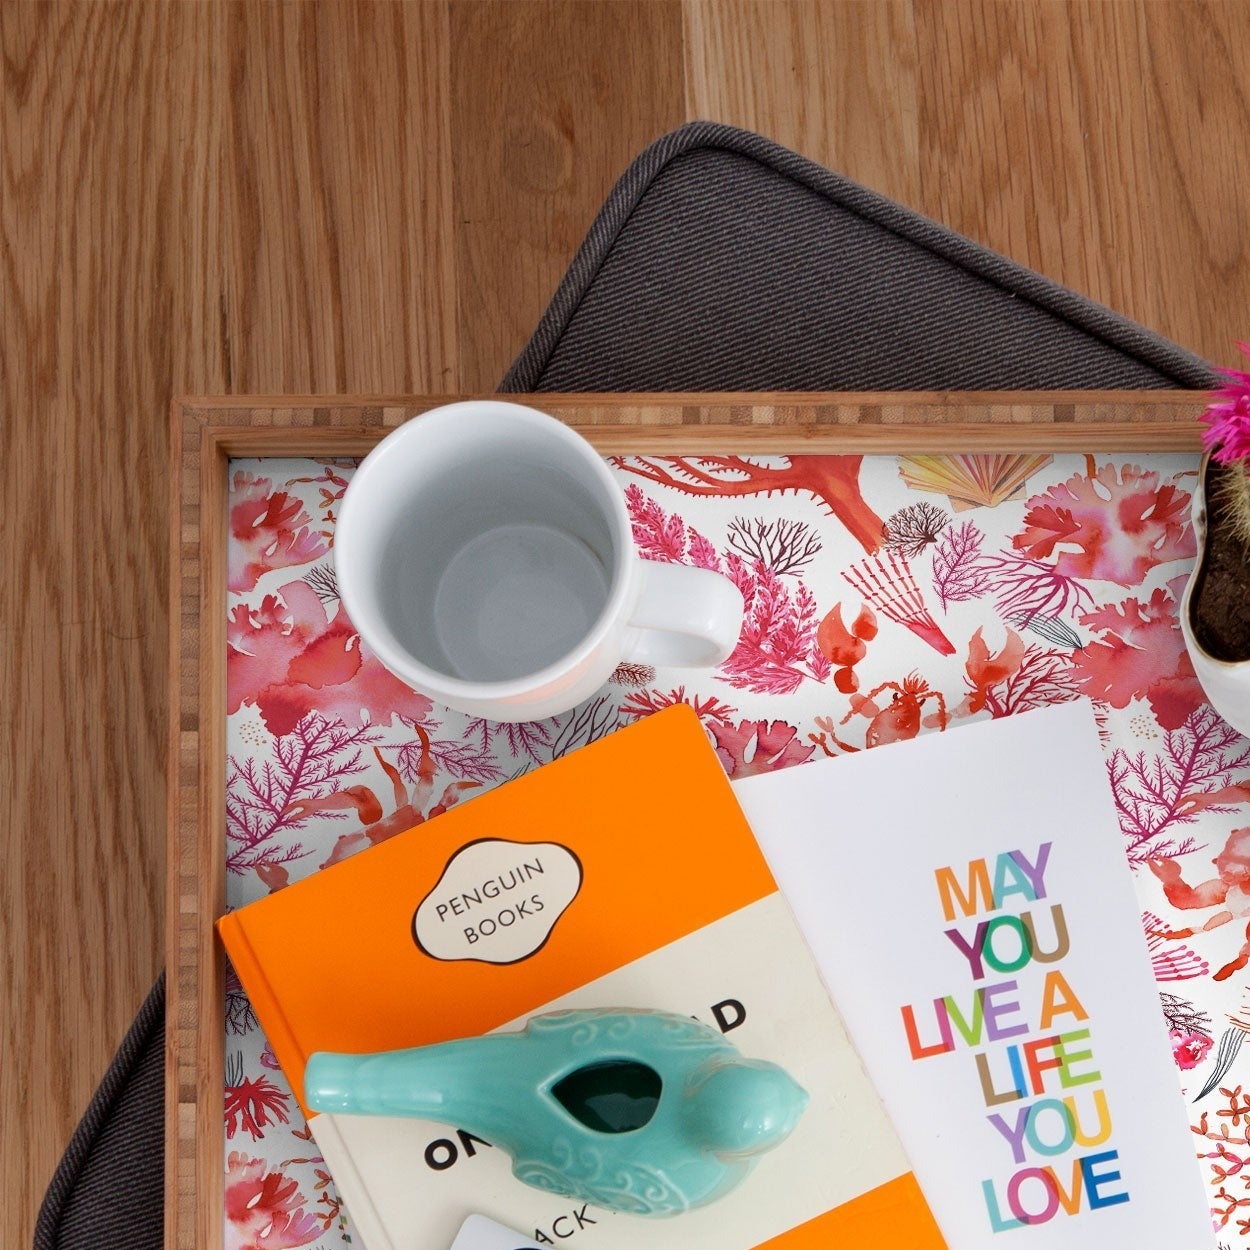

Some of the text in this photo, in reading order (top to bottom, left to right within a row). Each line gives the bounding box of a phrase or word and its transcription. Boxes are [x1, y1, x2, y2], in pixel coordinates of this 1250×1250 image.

[435, 857, 545, 923] PENGUIN
[463, 894, 545, 945] BOOKS
[934, 841, 1053, 922] MAY
[943, 903, 1071, 981] YOU
[900, 969, 1090, 1061] LIVE A
[974, 1028, 1102, 1108] LIFE
[986, 1088, 1113, 1165] YOU
[534, 1203, 598, 1246] ACK
[981, 1149, 1131, 1235] LOVE
